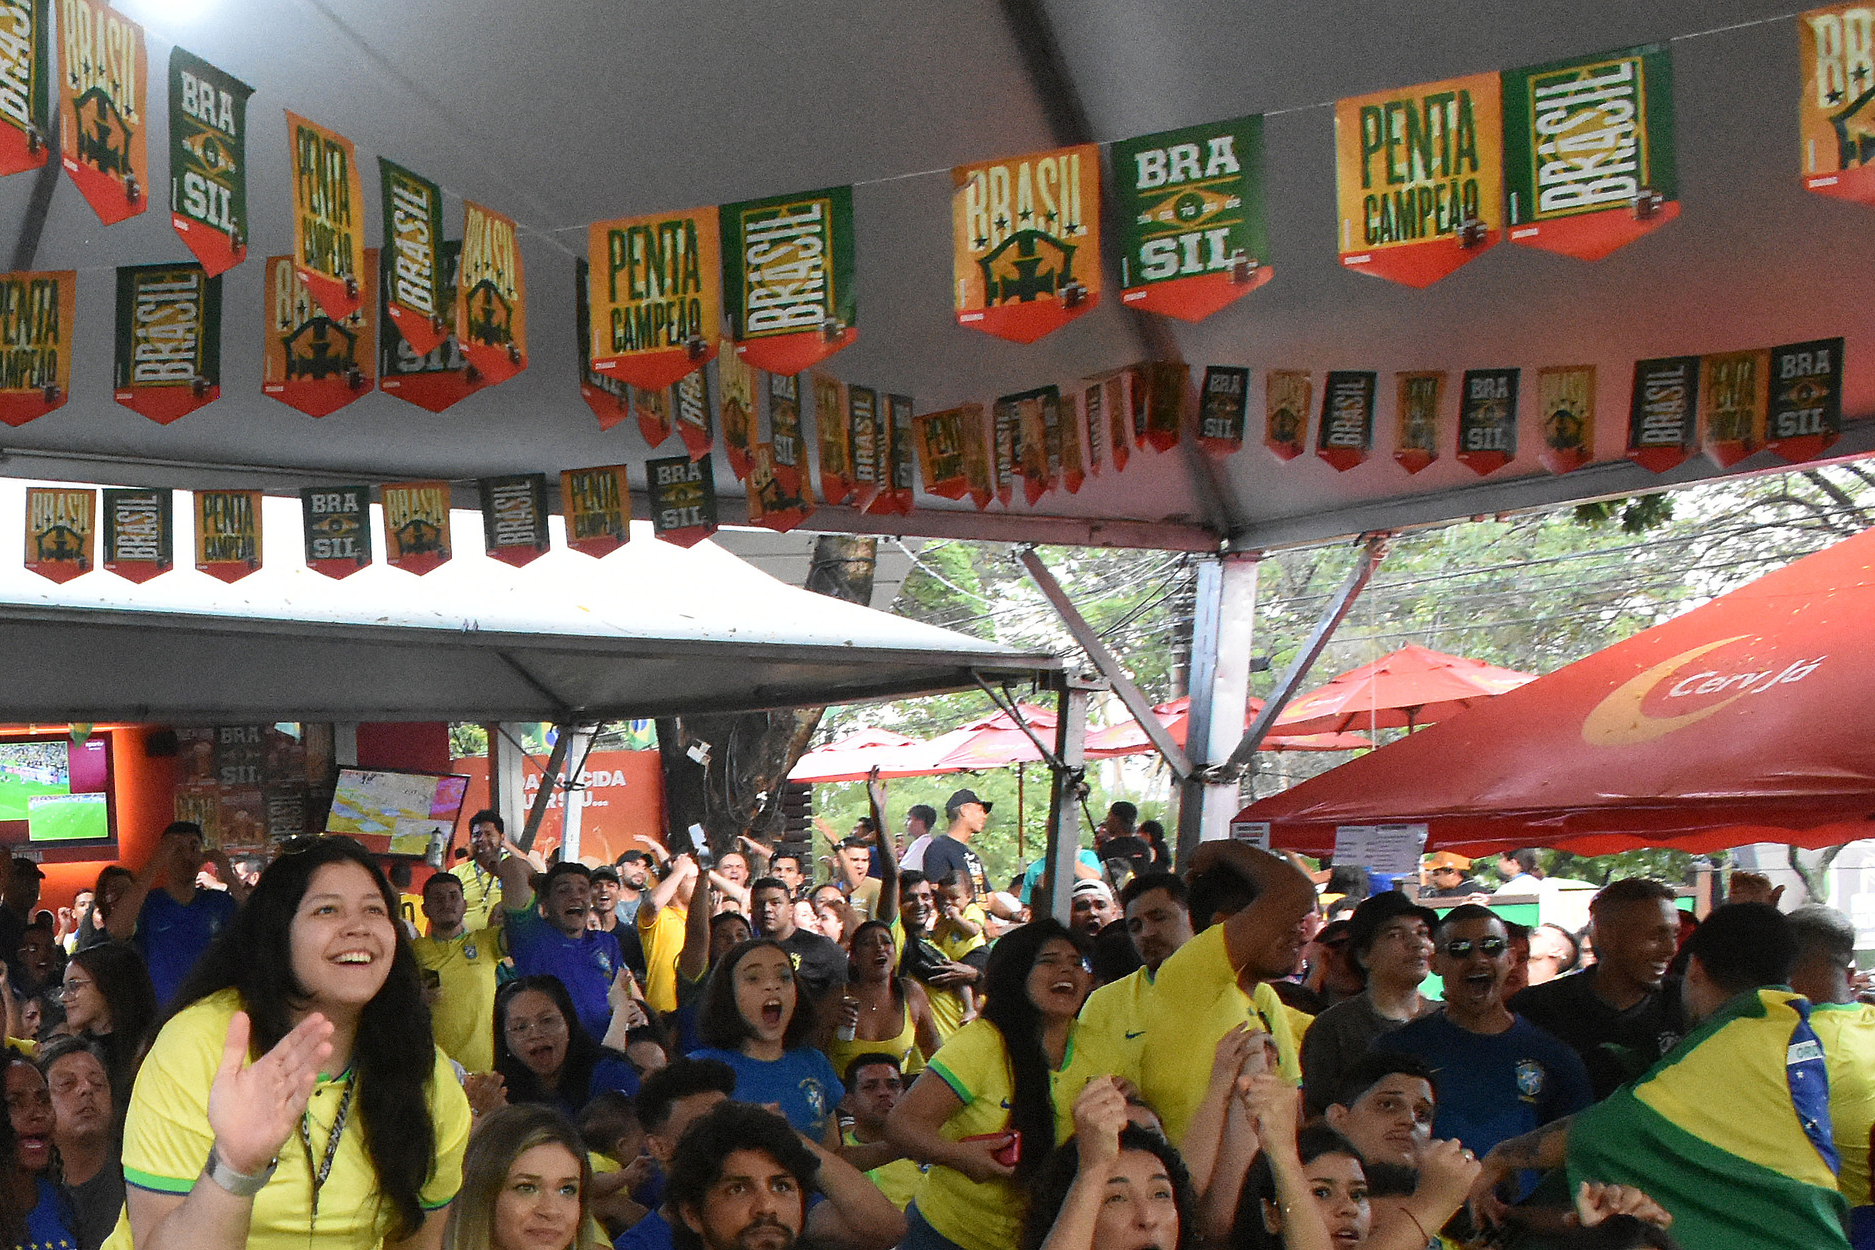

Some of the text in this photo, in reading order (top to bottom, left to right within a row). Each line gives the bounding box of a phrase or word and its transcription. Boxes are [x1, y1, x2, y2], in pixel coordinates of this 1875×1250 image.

[62, 0, 140, 126] BRASIL
[181, 71, 235, 136] BRA
[1135, 136, 1240, 189] BRA
[1361, 89, 1479, 189] PENTA
[1535, 61, 1638, 212] BRASIL
[183, 171, 237, 231] SIL
[297, 124, 351, 228] PENTA
[966, 153, 1088, 251] BRASIL
[393, 184, 433, 312] BRASIL
[462, 208, 518, 301] BRASIL
[607, 218, 702, 302] PENTA
[746, 202, 823, 332] BRASIL
[1141, 228, 1237, 280] SIL
[134, 272, 199, 382] BRASIL
[1210, 374, 1242, 393] BRA
[1470, 377, 1509, 399] BRA
[1781, 350, 1830, 378] BRA
[1204, 417, 1233, 438] SIL
[1330, 377, 1366, 445] BRASIL
[1642, 364, 1685, 443] BRASIL
[1777, 408, 1825, 438] SIL
[853, 396, 875, 482] BRASIL
[1467, 428, 1507, 450] SIL
[657, 461, 703, 486] BRA
[31, 493, 91, 535] BRASIL
[115, 494, 159, 560] BRASIL
[203, 494, 256, 534] PENTA
[311, 492, 359, 514] BRA
[386, 488, 446, 530] BRASIL
[493, 480, 536, 545] BRASIL
[661, 506, 708, 530] SIL
[312, 538, 360, 560] SIL
[1663, 655, 1829, 700] Cerv Já
[220, 727, 261, 743] BRA
[221, 765, 262, 785] SIL
